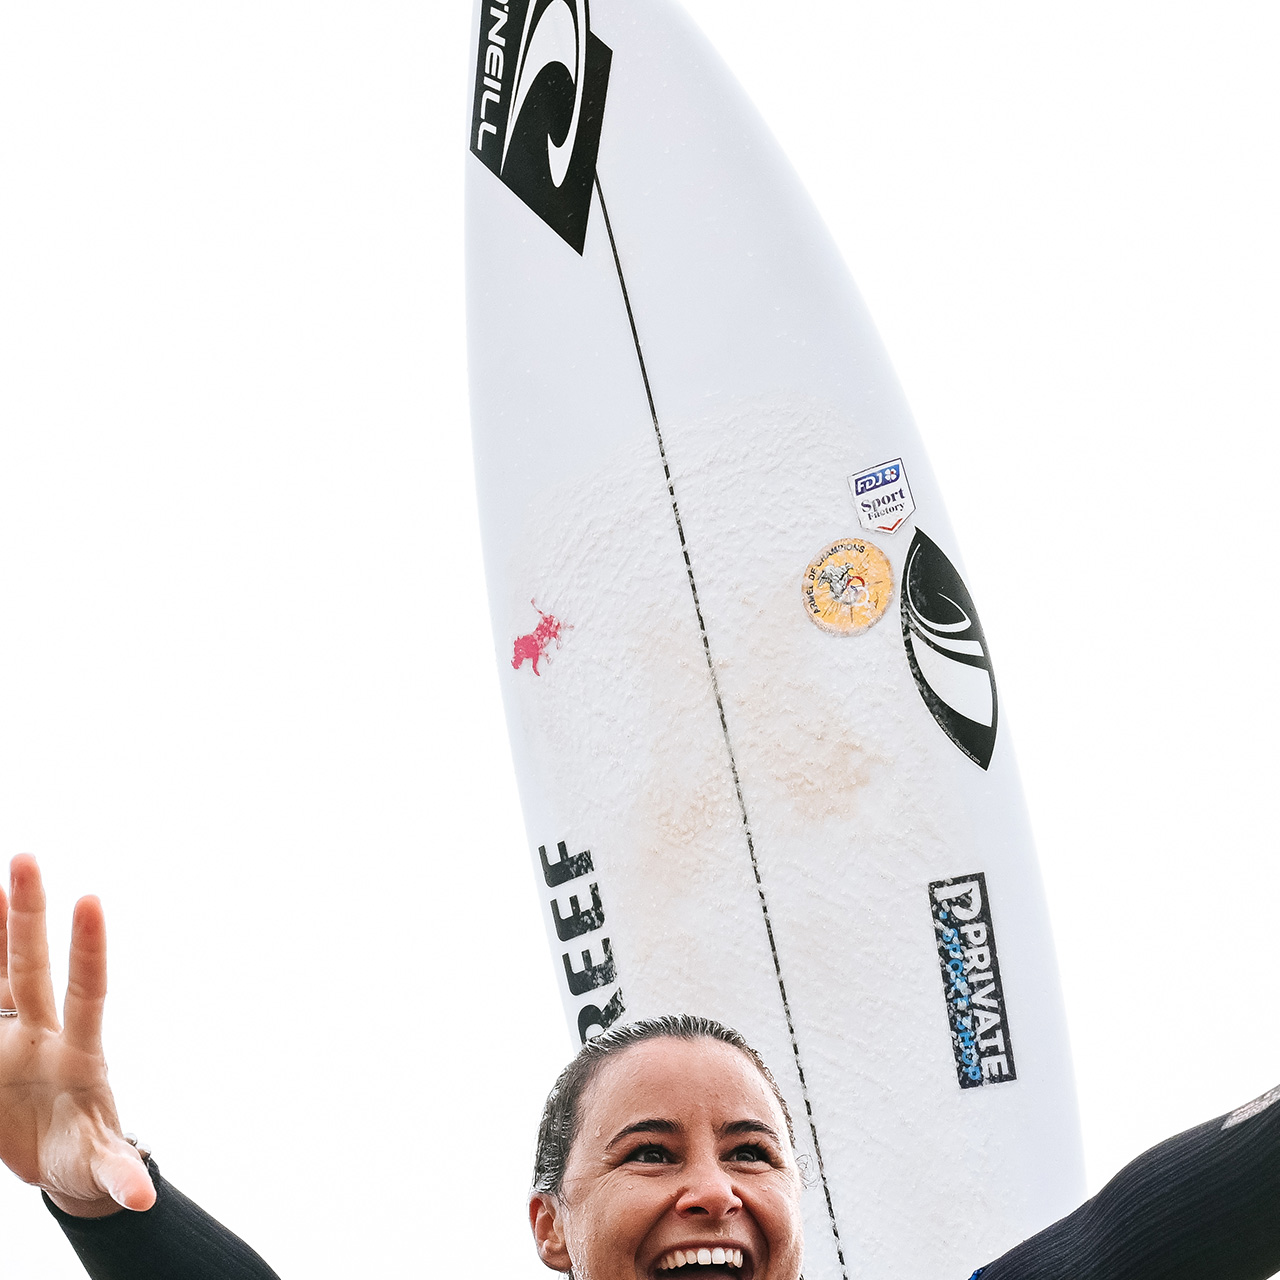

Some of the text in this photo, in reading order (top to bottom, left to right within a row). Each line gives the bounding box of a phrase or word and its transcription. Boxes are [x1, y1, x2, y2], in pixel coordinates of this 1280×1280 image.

[857, 472, 883, 493] FDJ
[861, 488, 905, 513] Sport
[959, 921, 1010, 1079] PRIVATE
